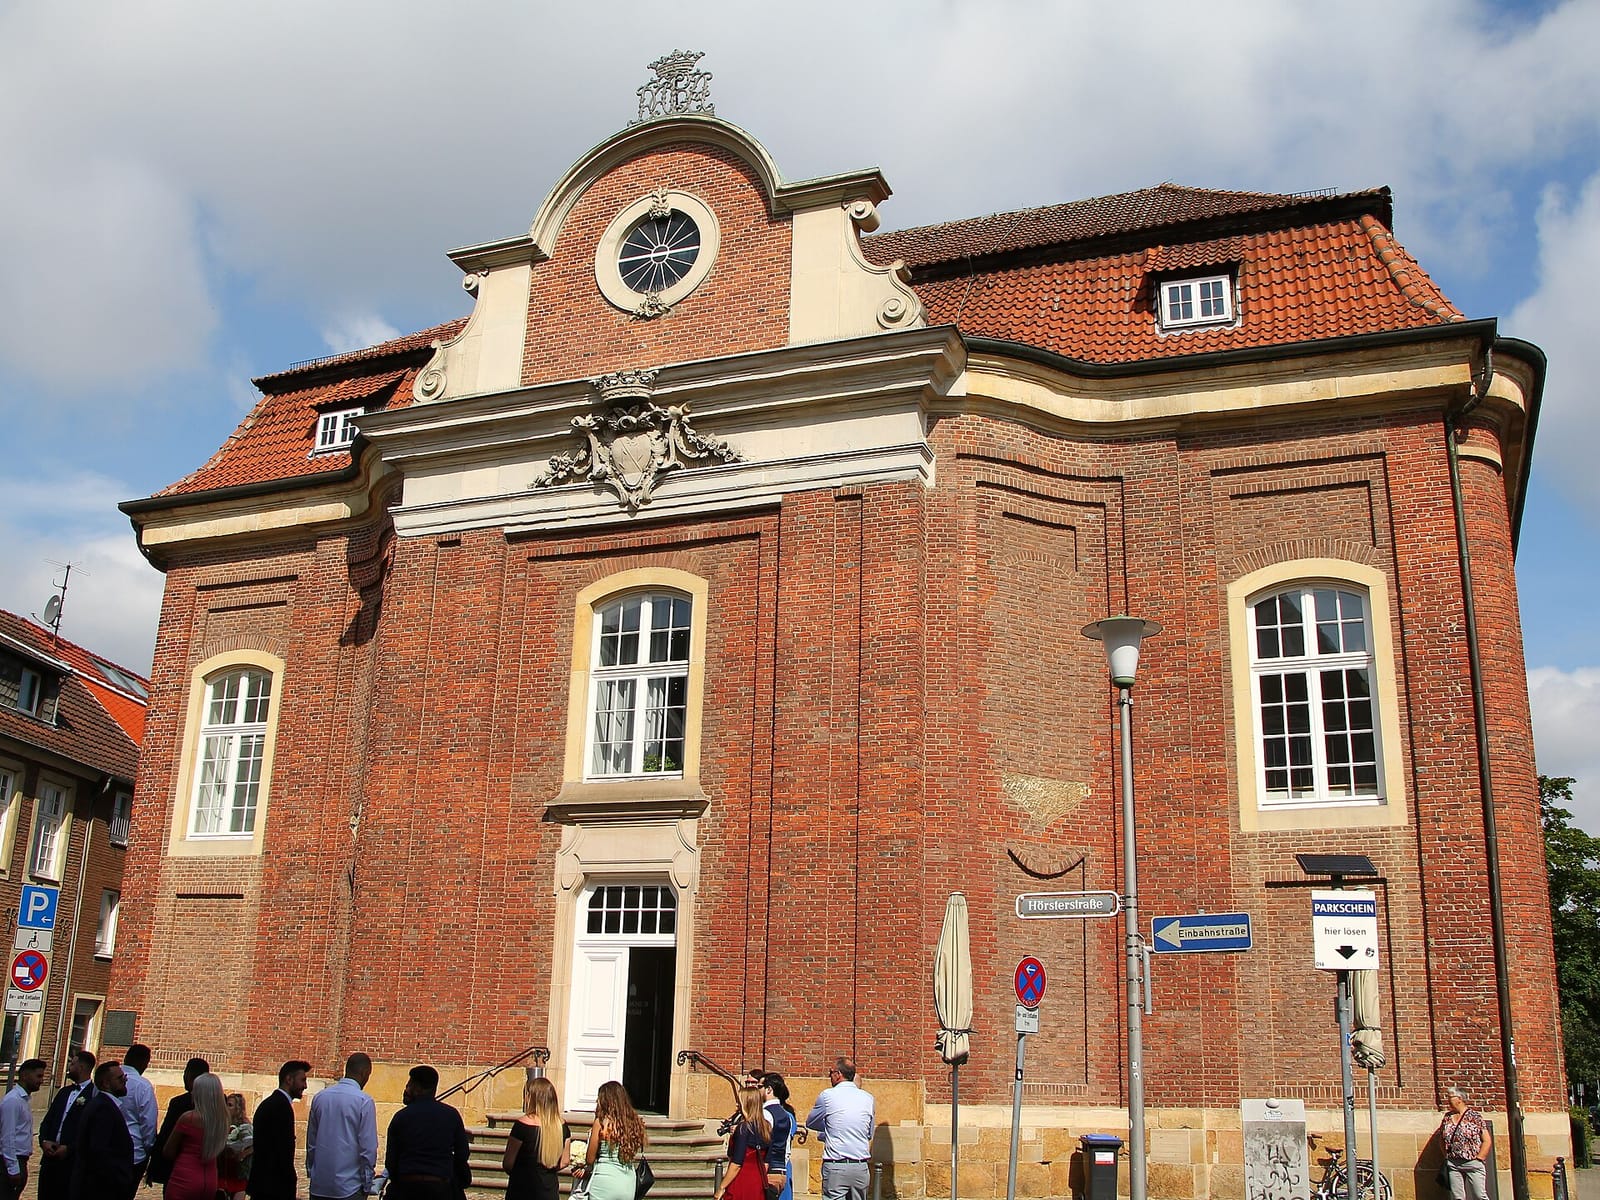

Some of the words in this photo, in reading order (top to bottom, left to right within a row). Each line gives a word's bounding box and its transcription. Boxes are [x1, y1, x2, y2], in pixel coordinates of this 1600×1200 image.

[27, 891, 49, 922] P
[1028, 898, 1103, 911] Hörsterstraße
[1314, 903, 1374, 913] PARKSCHEIN
[1178, 927, 1246, 938] Einbahnstraße
[1324, 927, 1341, 935] hier
[1343, 927, 1367, 935] lösen
